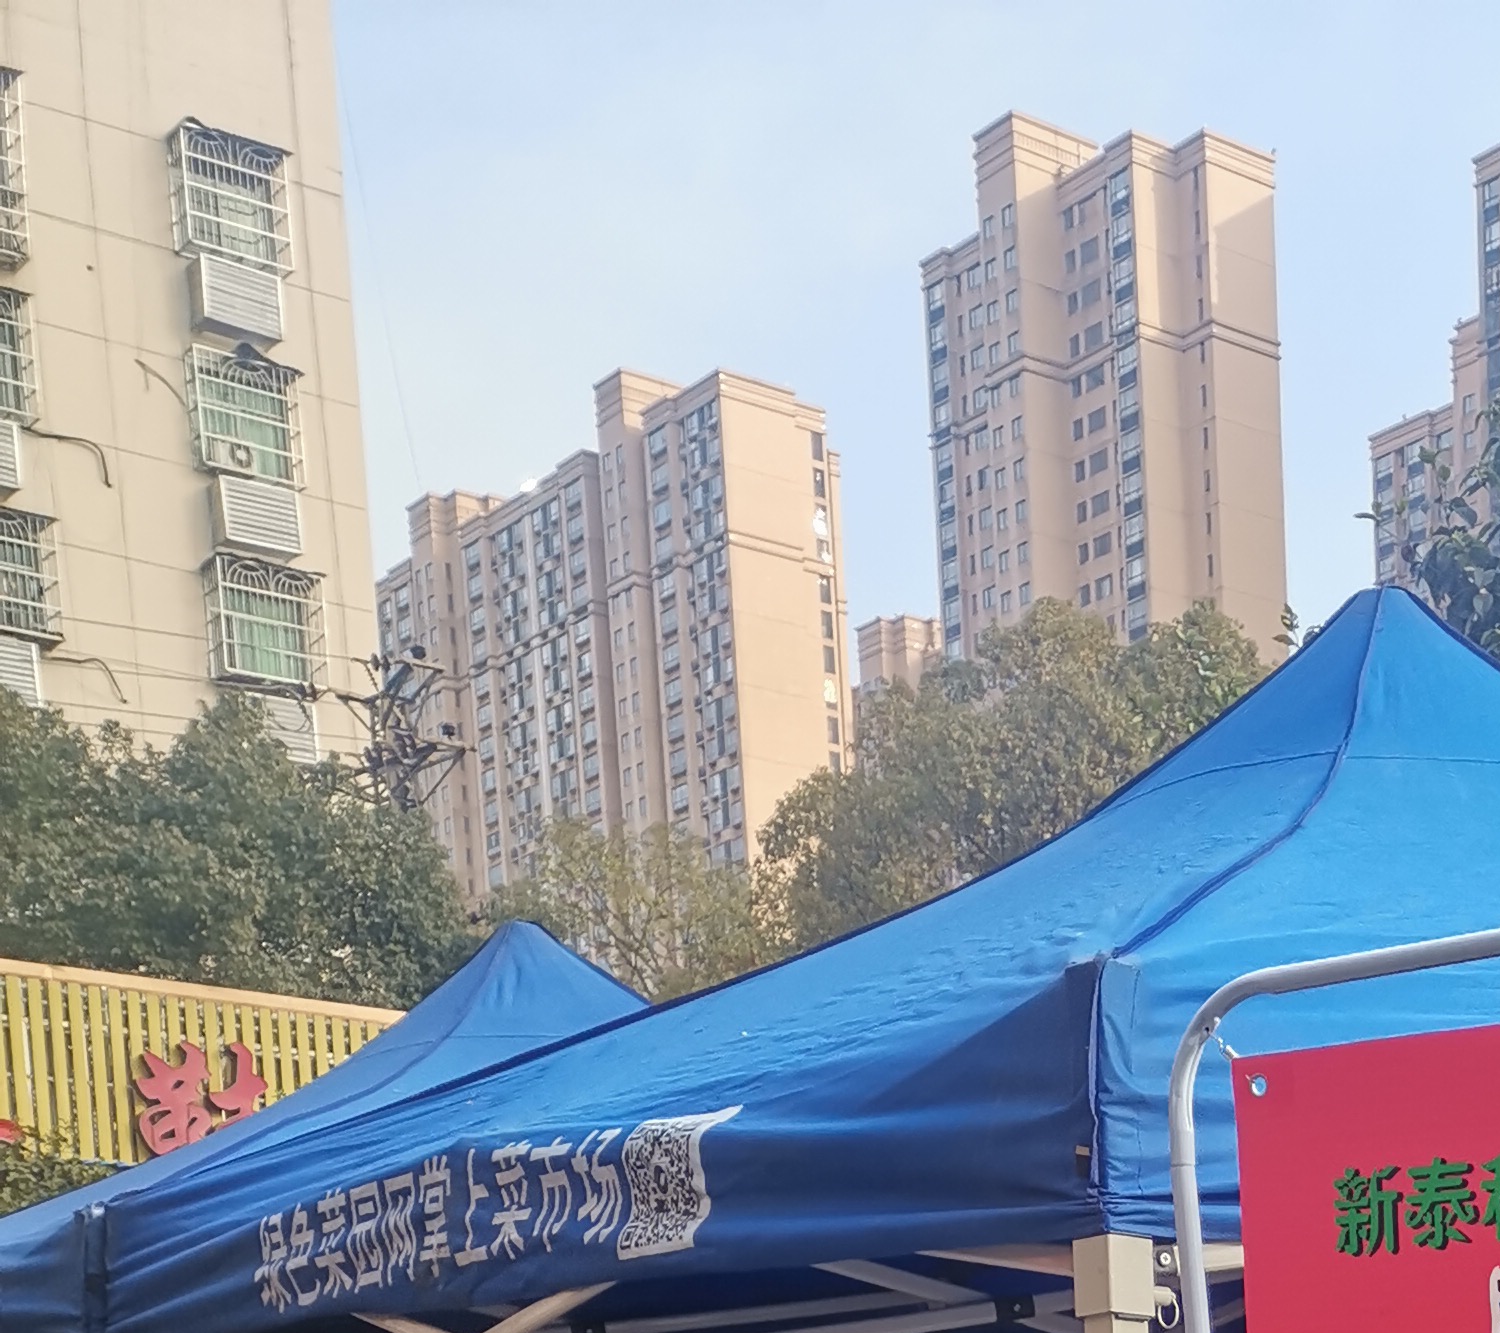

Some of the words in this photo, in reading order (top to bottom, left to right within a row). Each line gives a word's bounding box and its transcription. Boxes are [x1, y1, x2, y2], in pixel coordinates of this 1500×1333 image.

[256, 1127, 624, 1313] 绿色菜园网掌上菜市场
